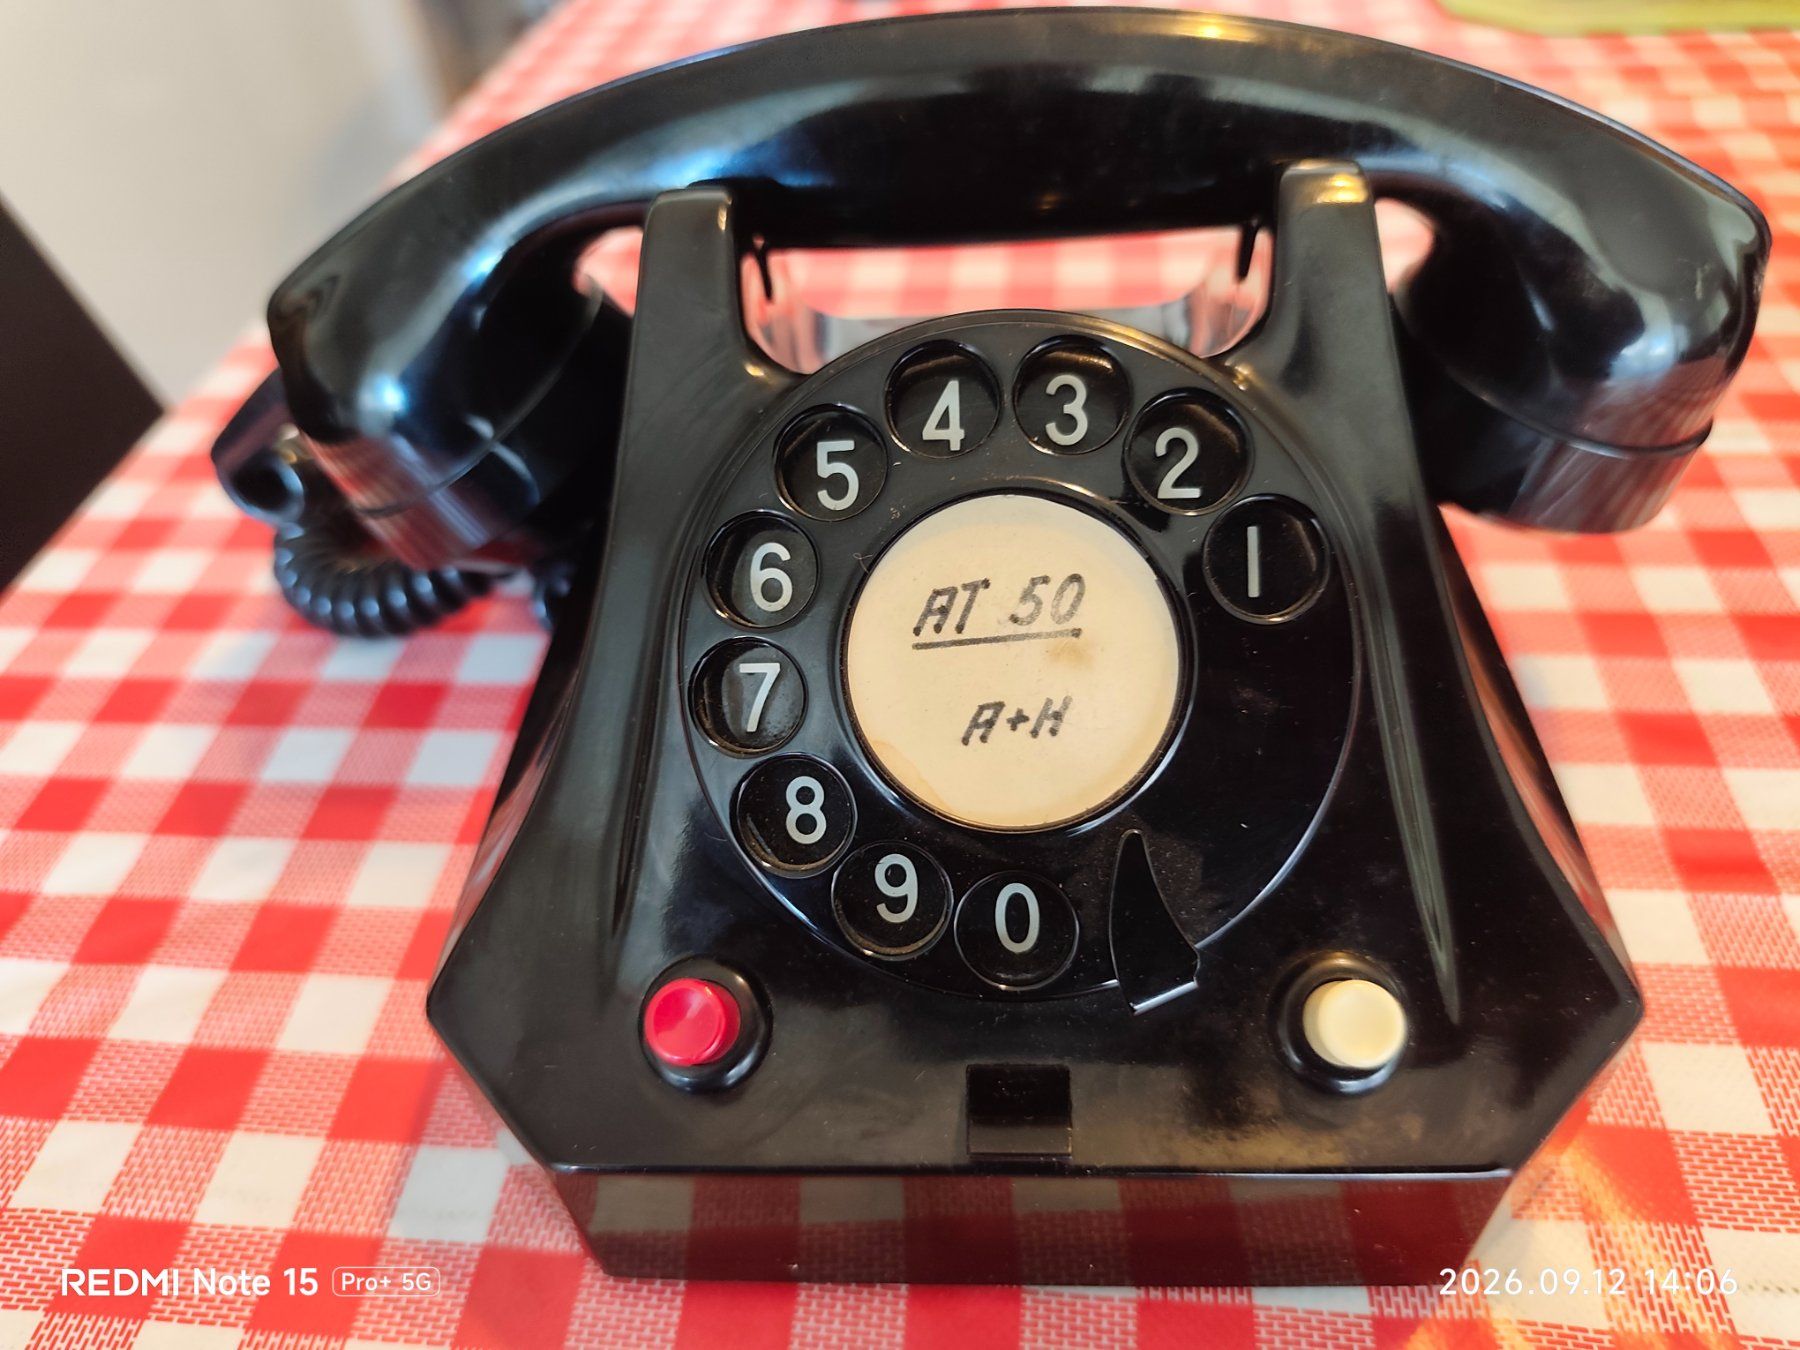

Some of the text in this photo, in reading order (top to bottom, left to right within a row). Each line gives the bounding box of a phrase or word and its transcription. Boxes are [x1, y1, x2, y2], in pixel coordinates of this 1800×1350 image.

[922, 379, 965, 451] 4
[1045, 374, 1089, 446] 3
[816, 439, 859, 511] 5
[1155, 427, 1201, 499] 2
[749, 542, 793, 613] 6
[1247, 526, 1260, 598] 1
[913, 573, 1086, 637] AT 50
[736, 662, 781, 733] 7
[785, 775, 827, 845] 8
[874, 853, 918, 923] 9
[994, 882, 1040, 953] 0
